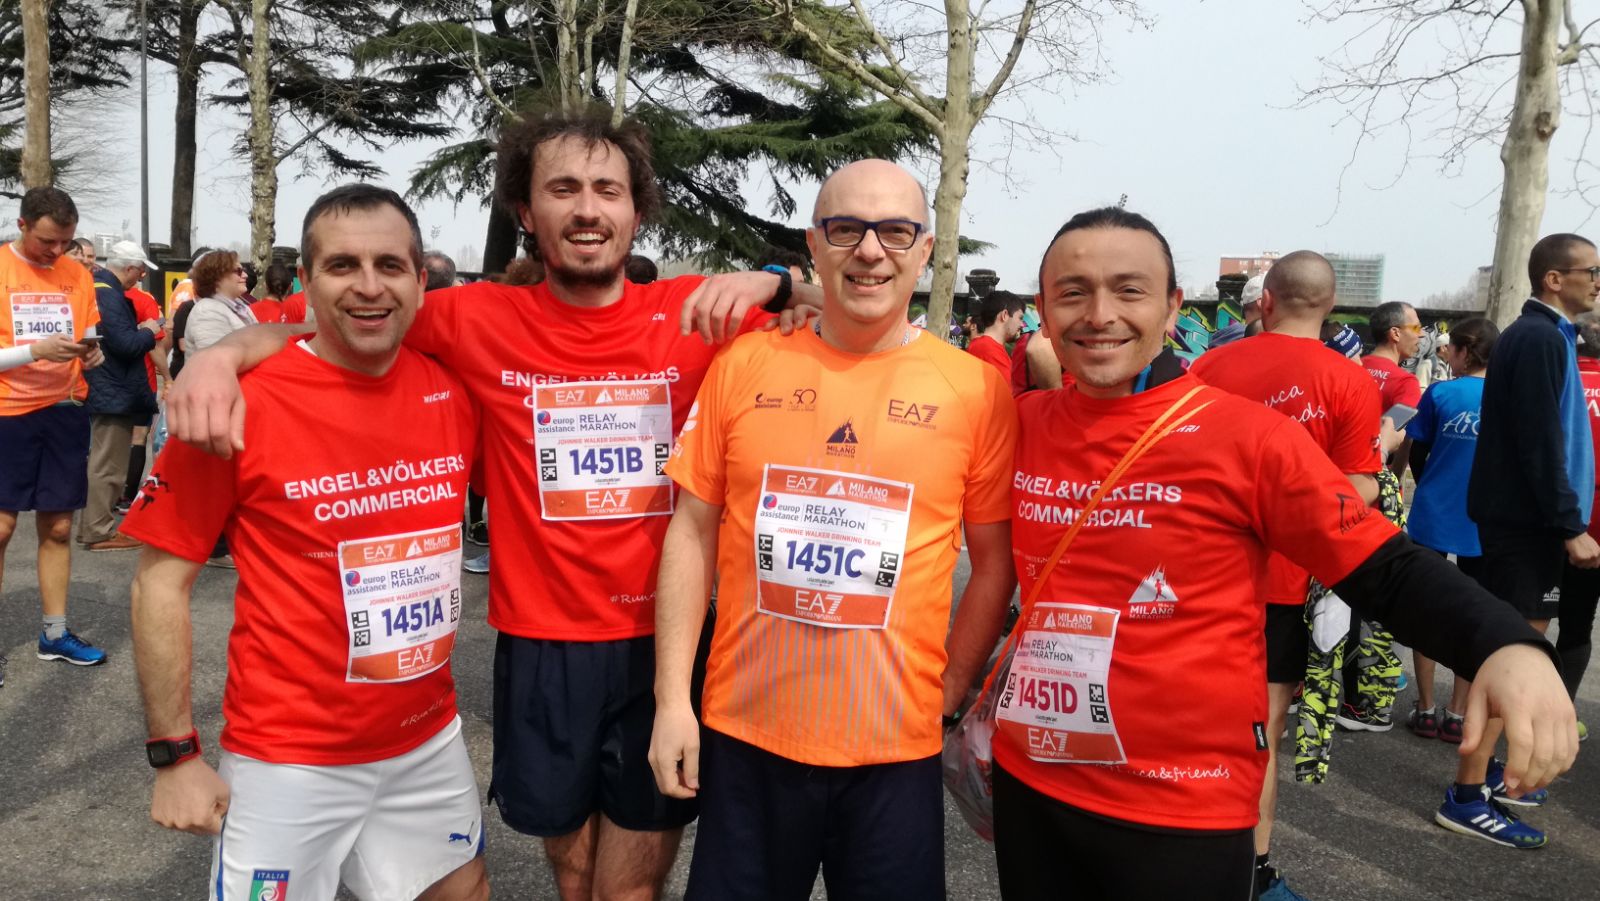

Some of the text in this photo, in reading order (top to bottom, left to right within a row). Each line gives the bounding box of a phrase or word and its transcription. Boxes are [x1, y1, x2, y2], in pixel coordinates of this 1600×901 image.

[28, 321, 62, 333] 1410C
[501, 366, 680, 387] ENGEÖKRS
[555, 390, 585, 403] EA7
[1264, 385, 1304, 407] uca
[553, 413, 617, 425] europ RELAY
[888, 399, 939, 423] EA7
[538, 421, 636, 433] assistance MARATHON
[827, 445, 856, 454] MILANO
[569, 447, 643, 476] 1451B
[284, 454, 465, 499] ENGEL&VÖLKERS
[786, 475, 888, 497] EA7 MILANO
[314, 481, 457, 522] COMMERCIAL
[585, 489, 631, 509] EA7
[760, 510, 866, 530] assistance MARATHON
[778, 504, 847, 517] europ RELAY
[776, 527, 882, 546] JOHNNIE WALKER DRINKING TEAM
[363, 544, 395, 560] EA7
[424, 534, 450, 546] MILANO
[786, 540, 866, 578] 1451C
[347, 572, 440, 596] assistance MARATHON
[362, 565, 426, 585] europ RELAY
[396, 592, 418, 601] WALKER
[795, 590, 844, 614] EA7
[381, 597, 444, 637] 1451A
[1057, 612, 1092, 625] MILANO
[1130, 605, 1174, 615] MILANO
[1057, 620, 1092, 631] MARATHON
[1032, 640, 1058, 651] RELAY
[398, 642, 435, 670] EA7
[1030, 650, 1073, 662] MARATHON
[1047, 668, 1071, 677] DRINKING
[1018, 677, 1078, 714] 1451D
[1028, 727, 1068, 751] EA7
[1128, 764, 1231, 782] ca&friends
